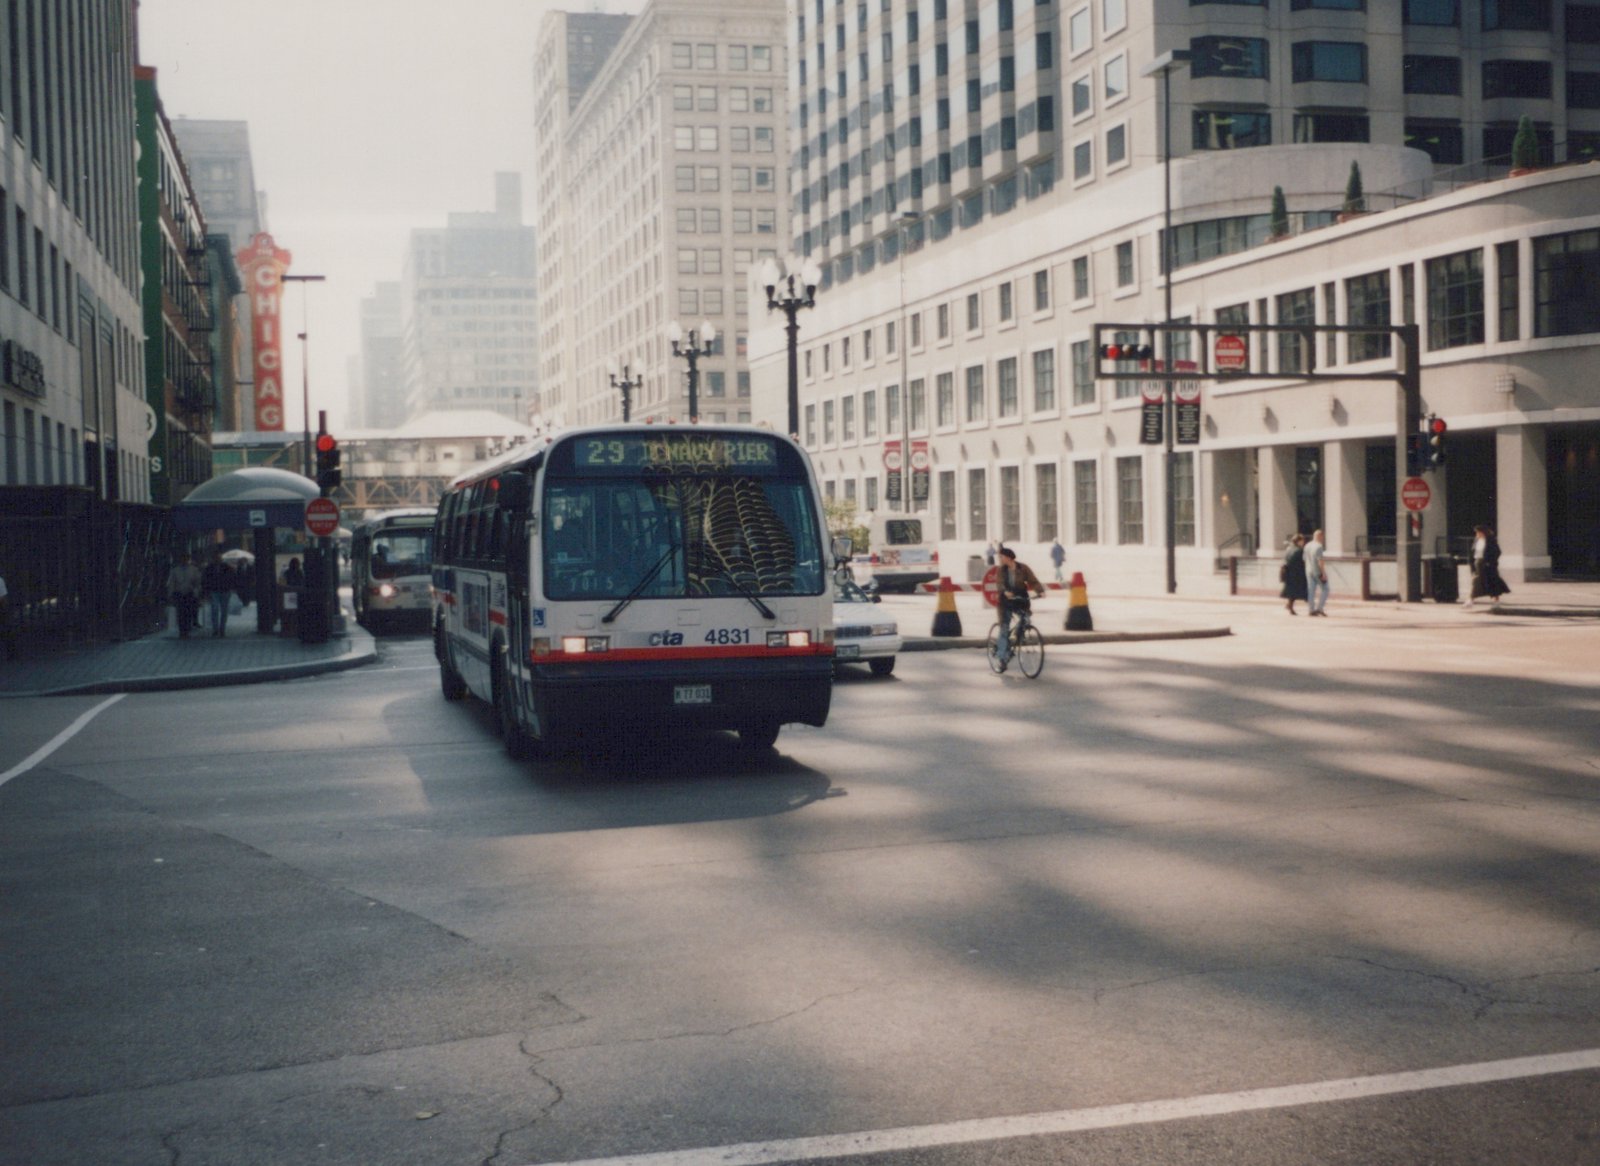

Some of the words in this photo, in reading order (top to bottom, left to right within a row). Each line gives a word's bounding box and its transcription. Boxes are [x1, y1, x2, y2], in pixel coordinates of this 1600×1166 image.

[256, 264, 281, 425] CHICAG
[588, 440, 625, 464] 29
[723, 440, 770, 461] PIER
[648, 630, 684, 646] cta
[704, 628, 749, 645] 4831
